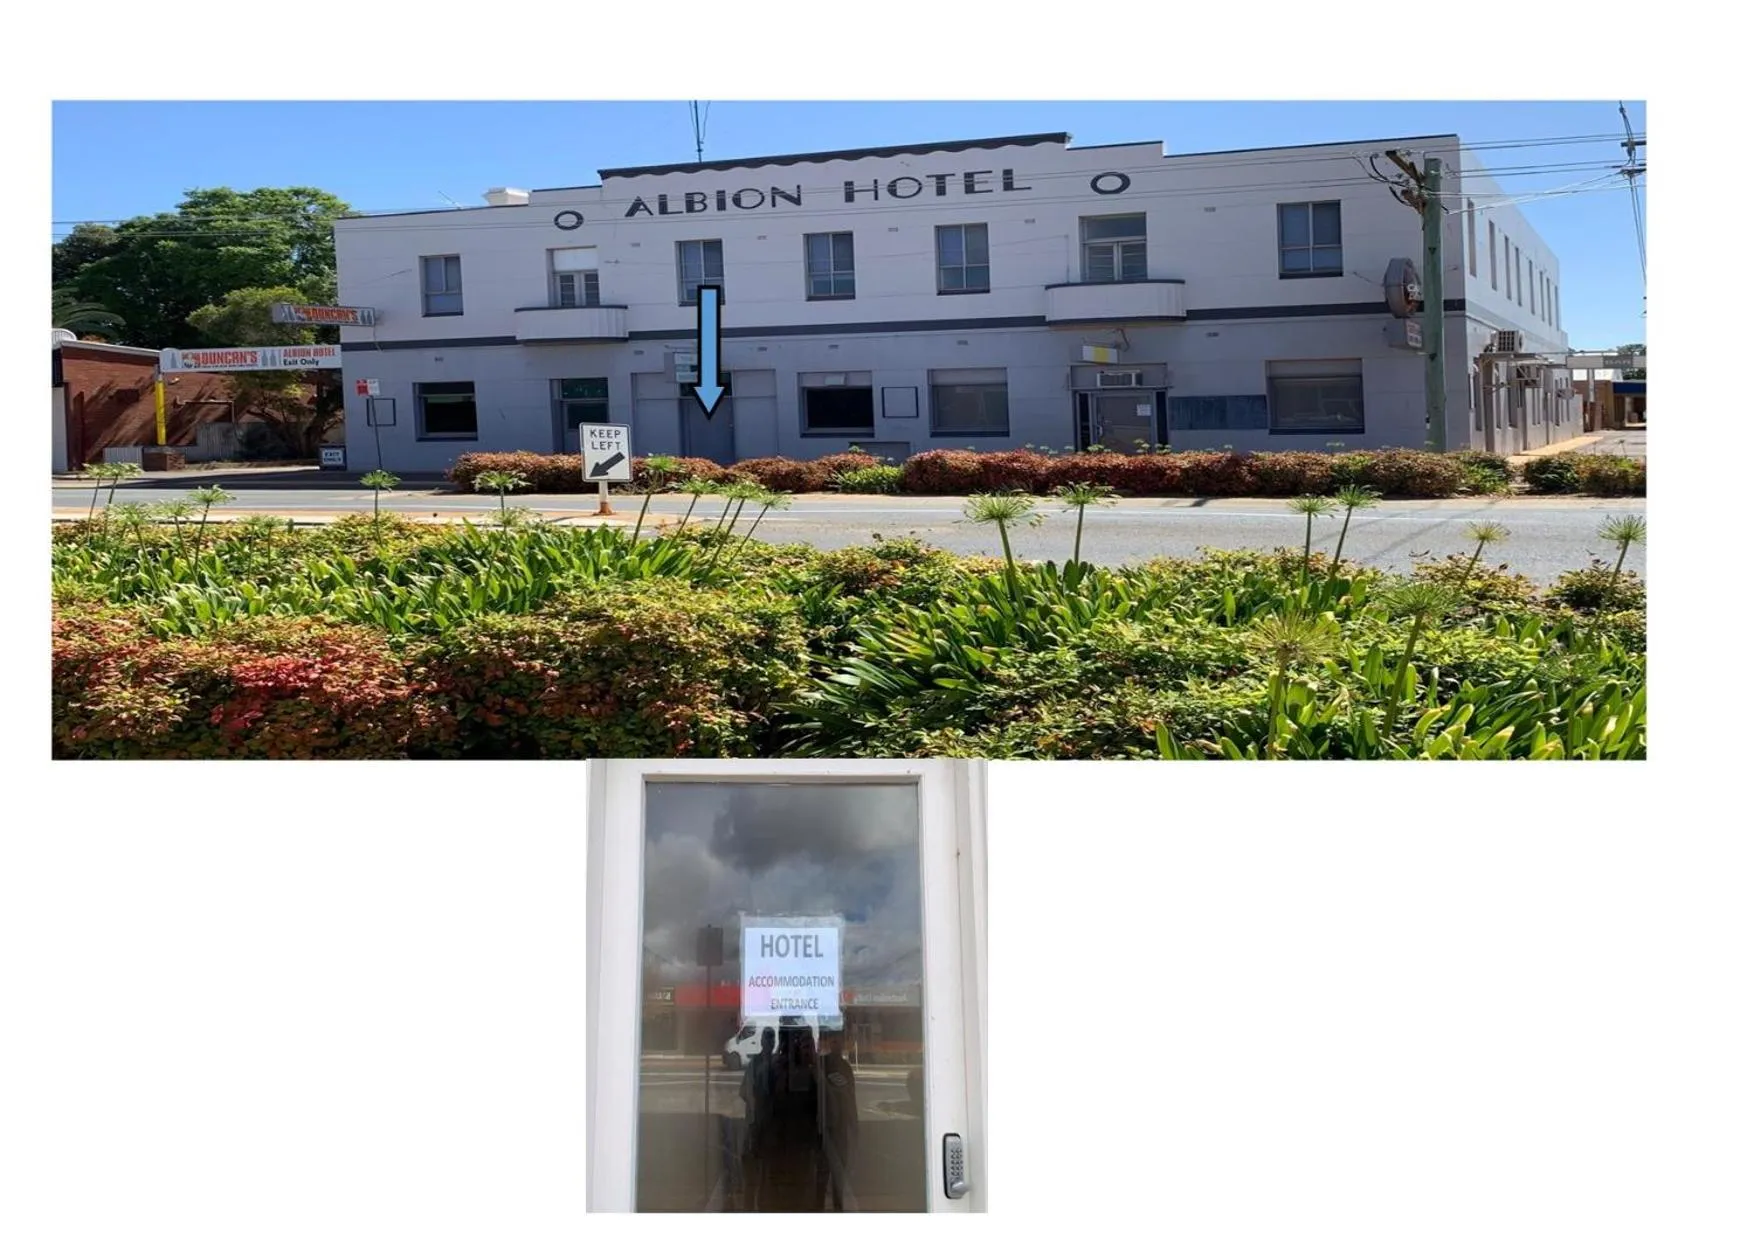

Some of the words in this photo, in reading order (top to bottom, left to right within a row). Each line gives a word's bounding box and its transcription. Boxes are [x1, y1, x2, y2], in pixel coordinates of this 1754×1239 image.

[624, 184, 802, 217] ALBION
[844, 168, 1032, 203] HOTEL
[201, 351, 258, 365] DUNCAN'S
[300, 358, 320, 366] Only
[590, 429, 621, 438] KEEP
[591, 441, 621, 450] LEFT
[761, 934, 824, 958] HOTEL
[748, 975, 835, 988] ACCOMMODATION
[769, 998, 819, 1010] ENTRANCE
